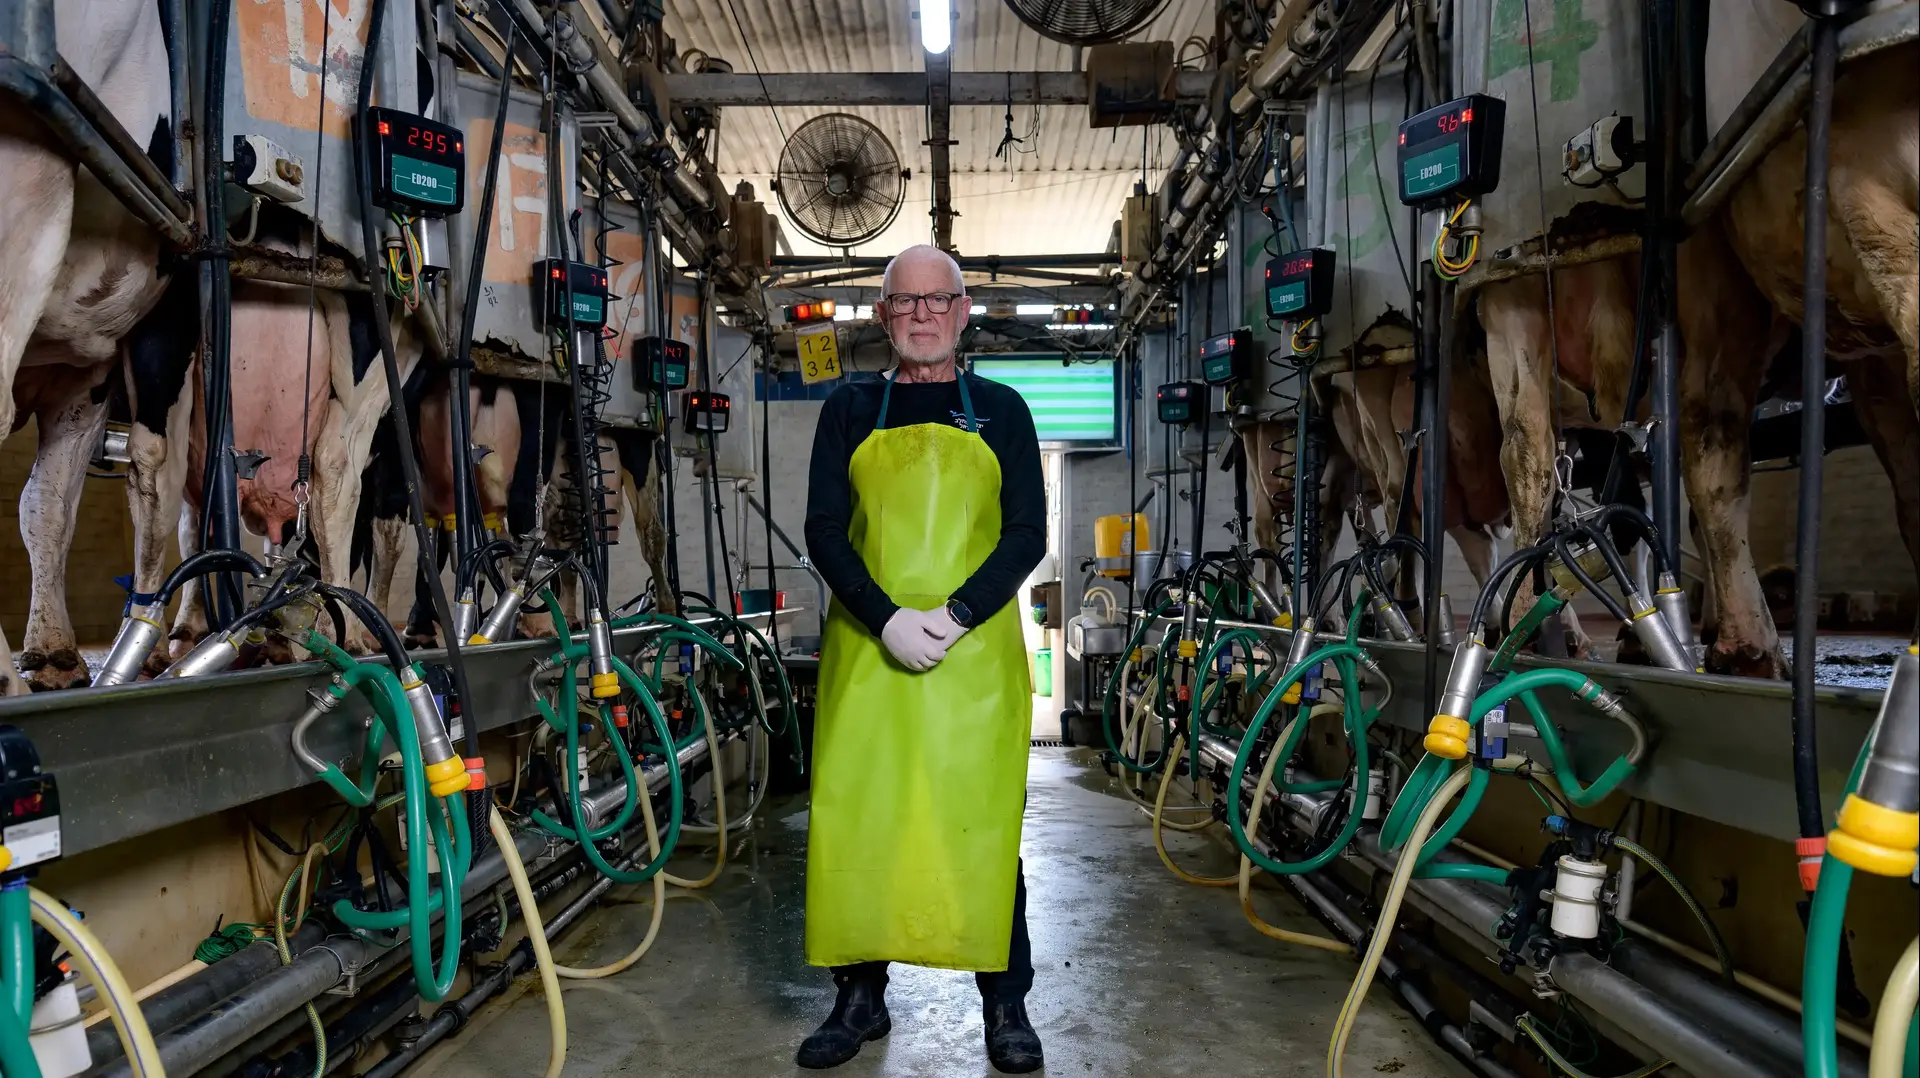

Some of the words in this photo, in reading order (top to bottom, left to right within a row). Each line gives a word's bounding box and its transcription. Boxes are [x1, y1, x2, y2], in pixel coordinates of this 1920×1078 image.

[408, 126, 447, 153] 295
[411, 172, 437, 189] ED200
[1420, 162, 1442, 180] ED200
[804, 339, 812, 354] 1
[820, 335, 832, 352] 2
[807, 361, 818, 377] 3
[824, 356, 835, 372] 4
